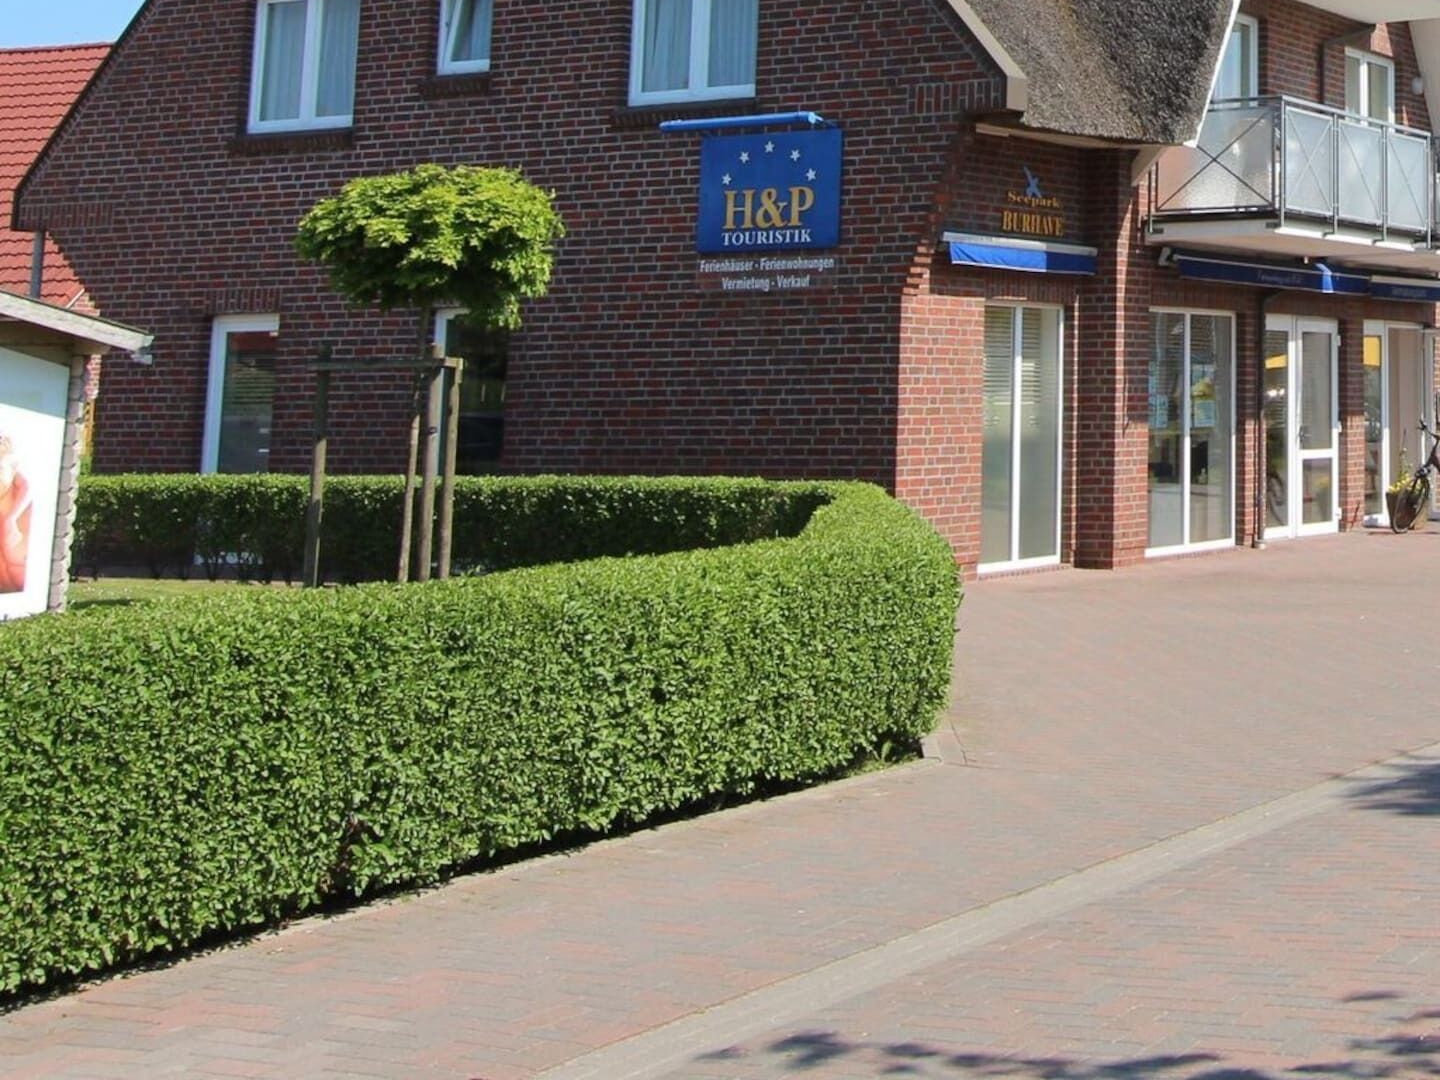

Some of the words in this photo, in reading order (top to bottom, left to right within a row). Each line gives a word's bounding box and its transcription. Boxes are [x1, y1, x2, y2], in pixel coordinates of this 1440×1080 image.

[723, 186, 815, 229] H&P
[1007, 190, 1060, 208] Seepark
[1002, 210, 1064, 236] BURHAVE
[722, 228, 812, 246] TOURISTIK
[700, 258, 754, 273] Ferienhäuser
[760, 256, 834, 272] Ferienwohnungen
[722, 275, 770, 292] Vermietung
[776, 274, 811, 289] Verkauf
